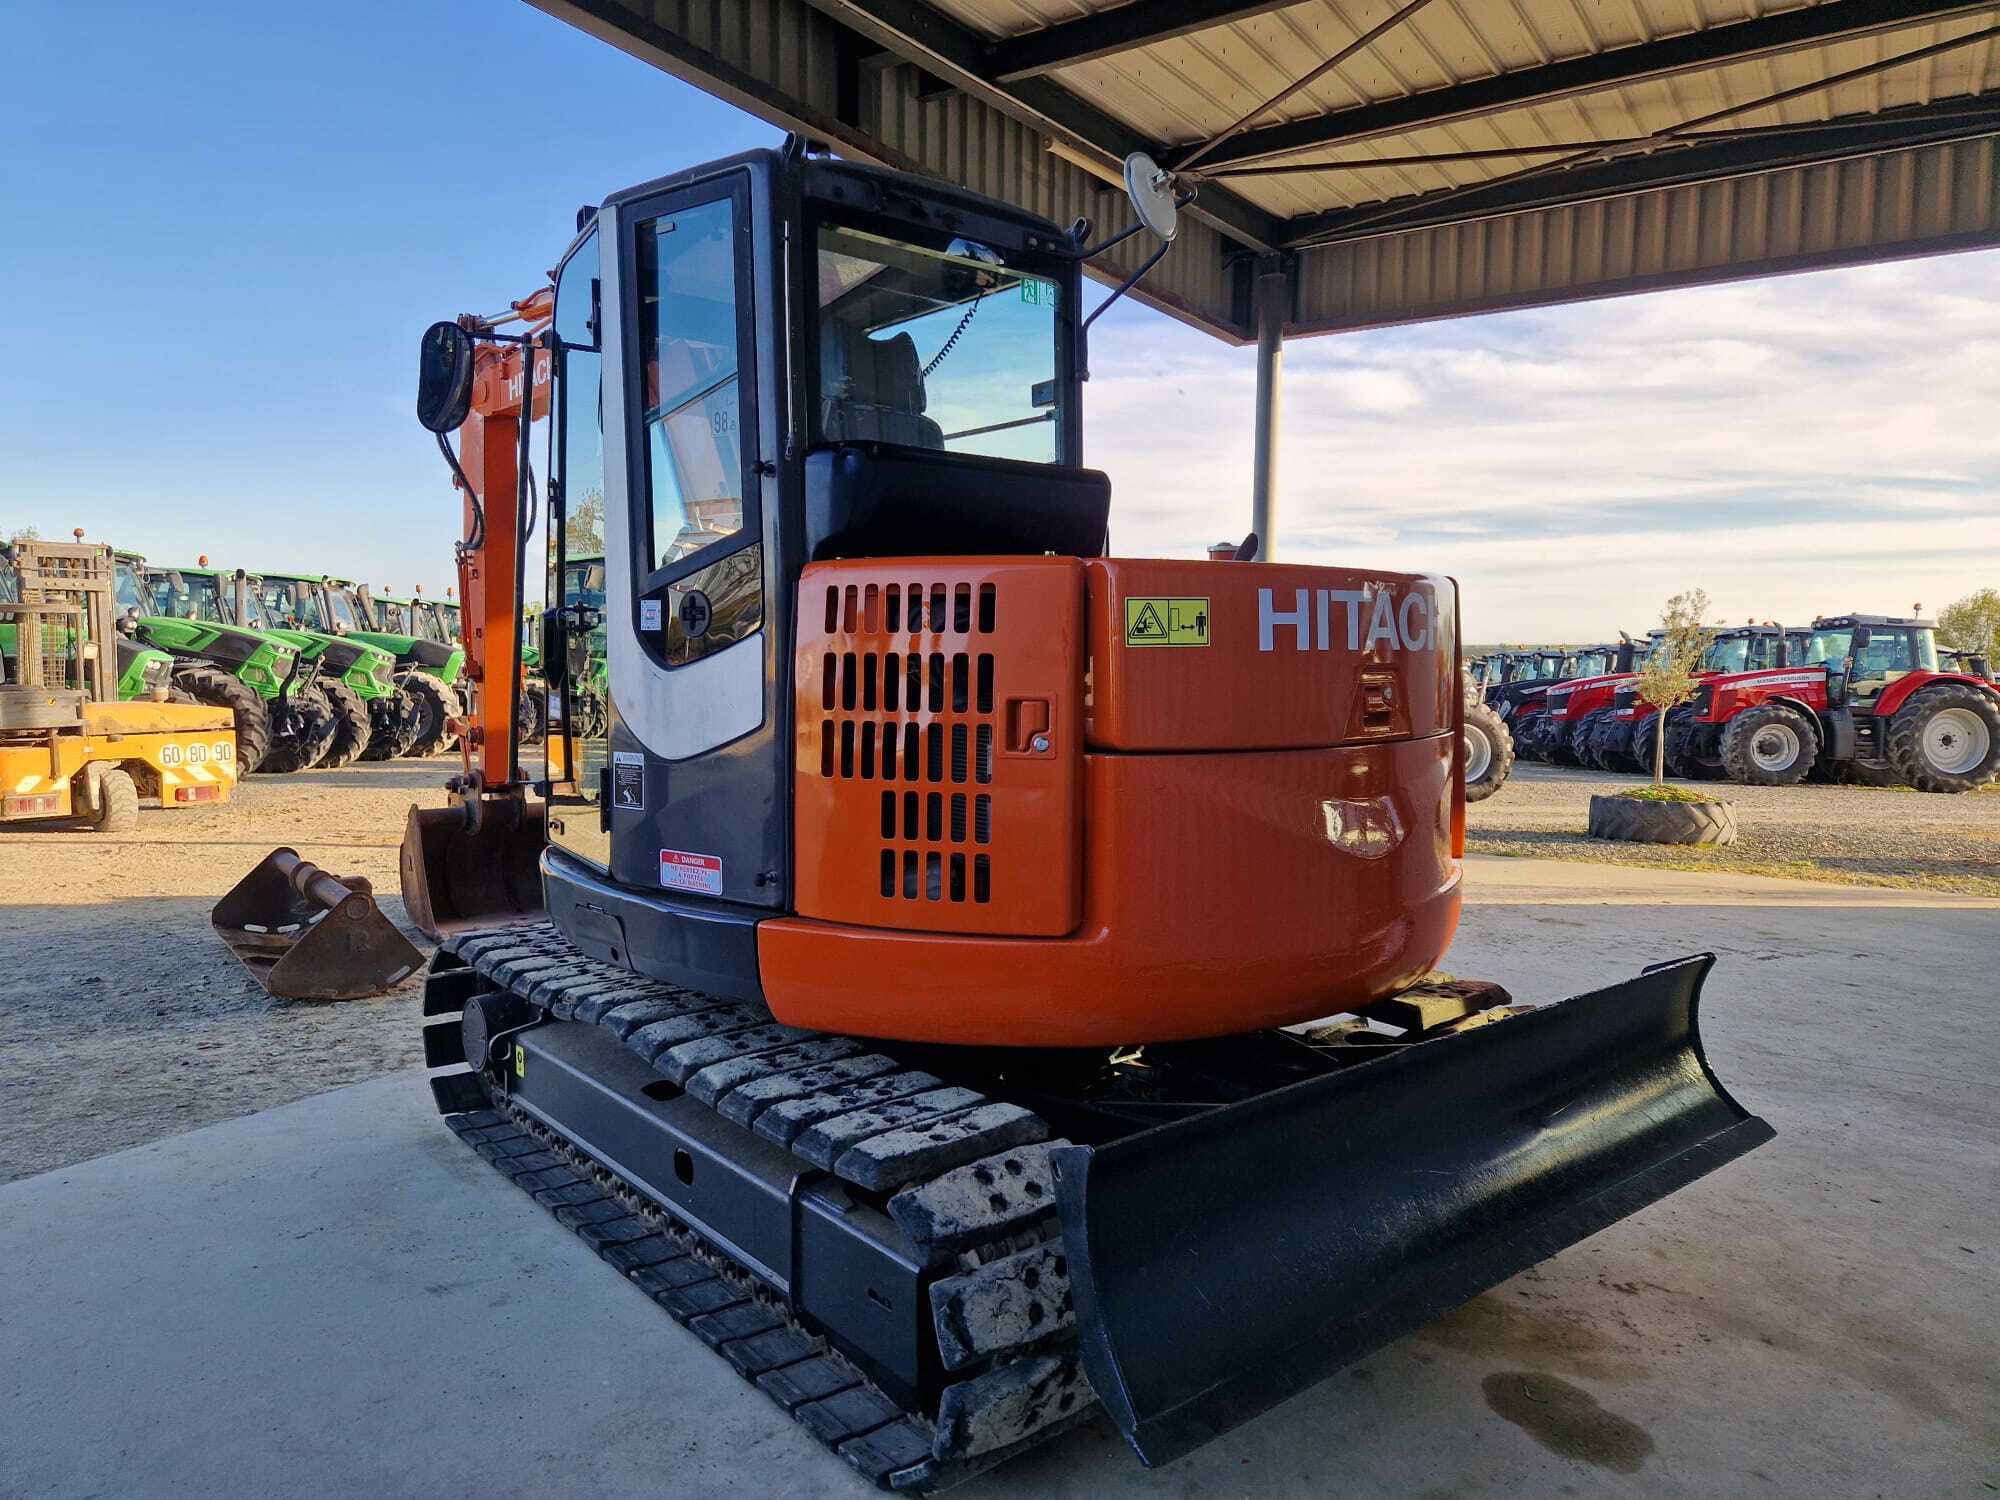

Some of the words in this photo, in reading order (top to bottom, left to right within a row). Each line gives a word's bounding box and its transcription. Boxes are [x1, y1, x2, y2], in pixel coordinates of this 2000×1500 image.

[714, 411, 728, 433] 98
[162, 746, 180, 764] 60
[190, 746, 206, 763] 80
[215, 744, 231, 761] 90
[681, 855, 705, 866] DANGER
